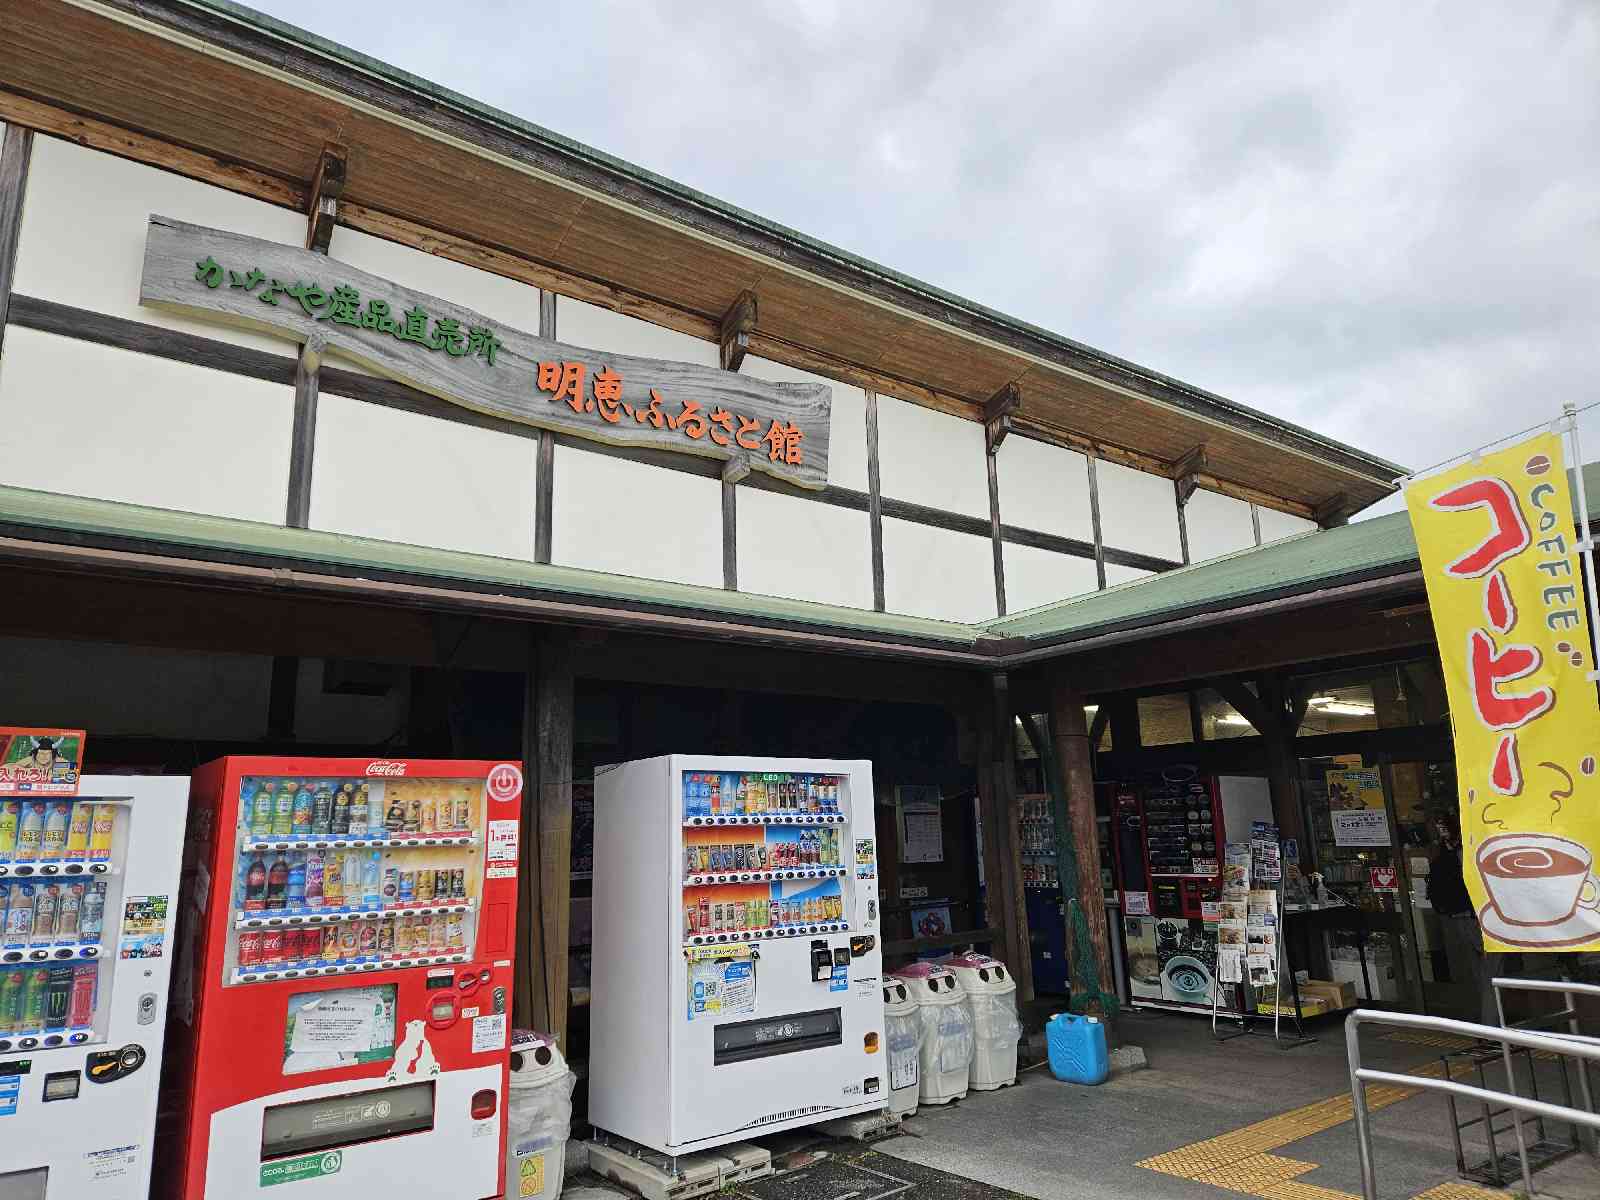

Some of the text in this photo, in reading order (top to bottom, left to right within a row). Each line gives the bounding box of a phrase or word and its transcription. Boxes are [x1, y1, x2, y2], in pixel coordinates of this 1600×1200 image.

[536, 360, 803, 465] 明恵ふるさと館
[1531, 483, 1579, 630] COFFEE
[1429, 477, 1553, 796] コーヒー
